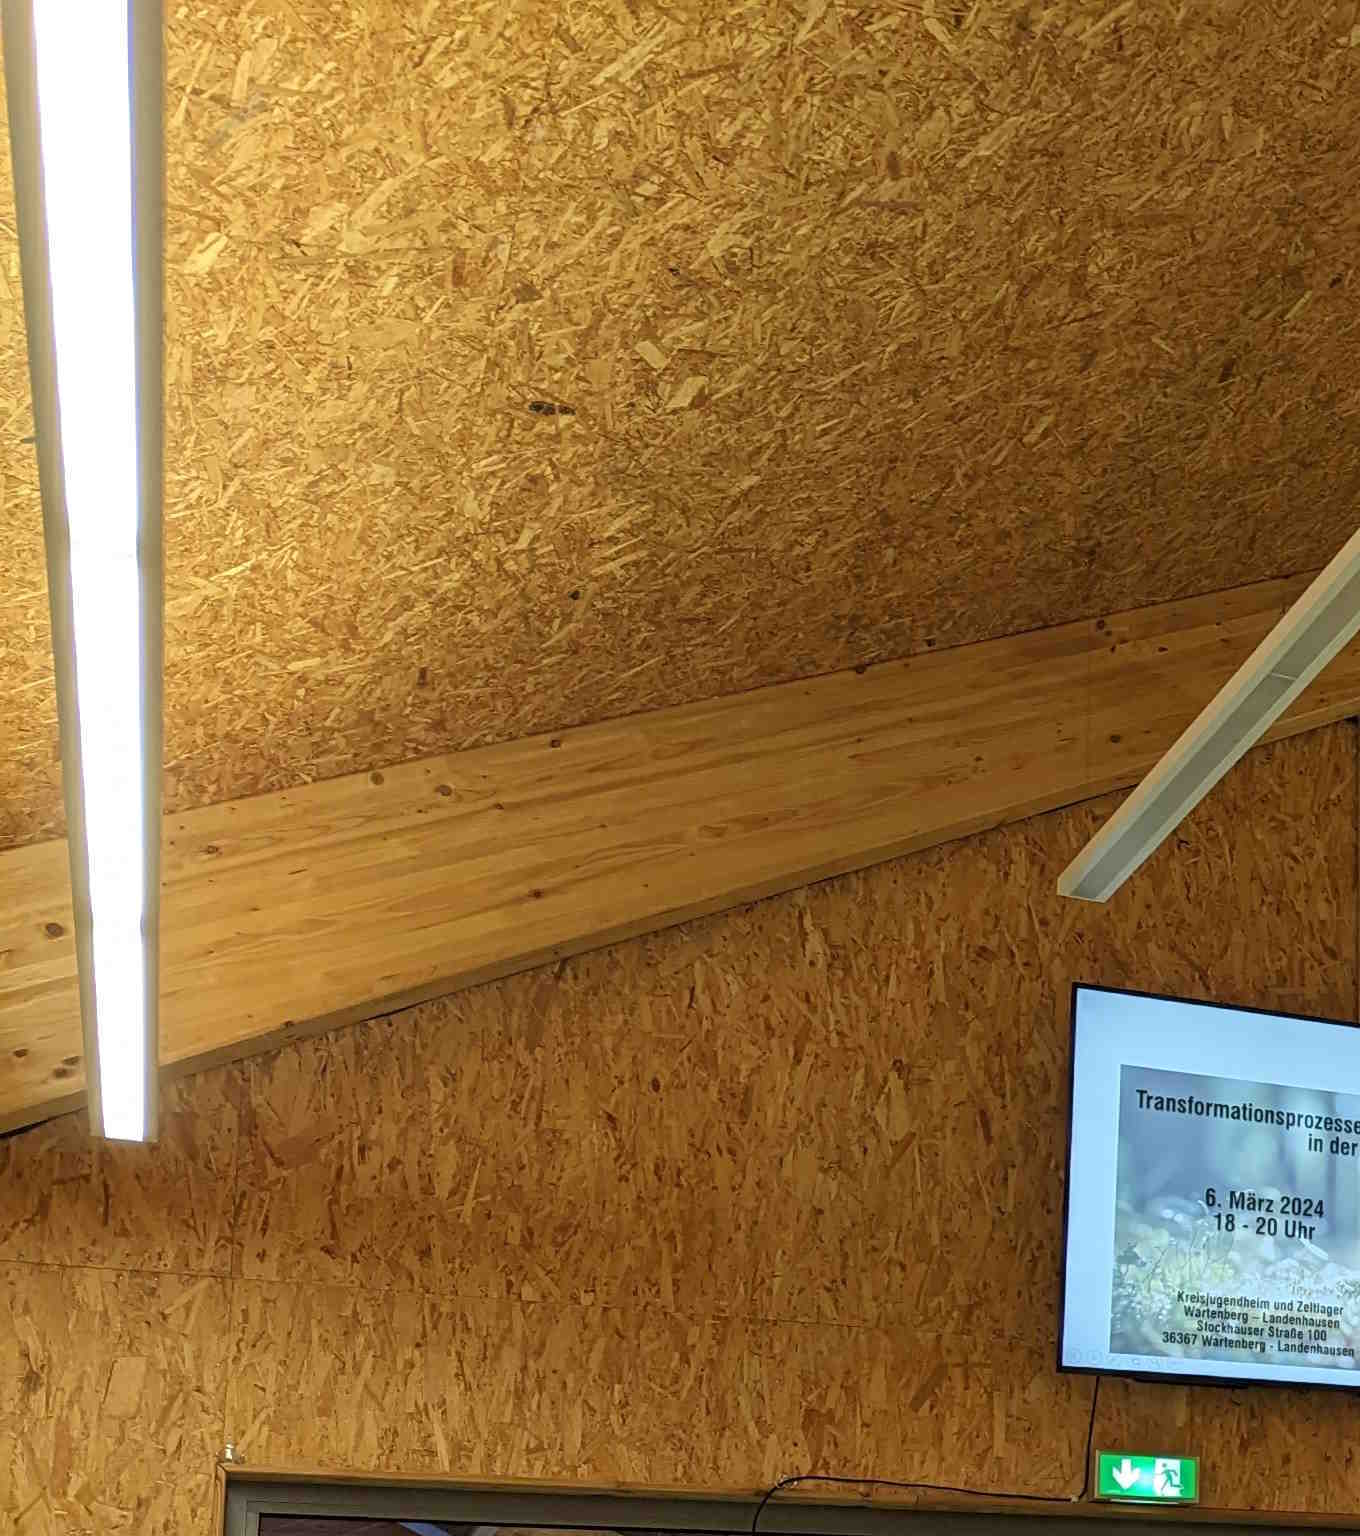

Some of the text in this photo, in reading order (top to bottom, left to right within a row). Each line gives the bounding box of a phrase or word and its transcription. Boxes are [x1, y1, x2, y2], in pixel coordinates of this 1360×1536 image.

[1308, 1133, 1323, 1153] in
[1330, 1135, 1358, 1156] der
[1205, 1187, 1324, 1218] 6. März 2024
[1214, 1213, 1235, 1232] 18
[1256, 1217, 1278, 1236] 20
[1284, 1219, 1315, 1241] Uhr
[1177, 1290, 1344, 1317] Kreisjugendheim und Zeltlager
[1184, 1305, 1249, 1324] Wartenberg
[1262, 1312, 1340, 1329] Landenhausen
[1196, 1319, 1327, 1342] Stockhauser Straße 100
[1162, 1331, 1197, 1346] 36367
[1201, 1334, 1266, 1354] Wartenberg
[1277, 1341, 1355, 1358] Landenhausen
